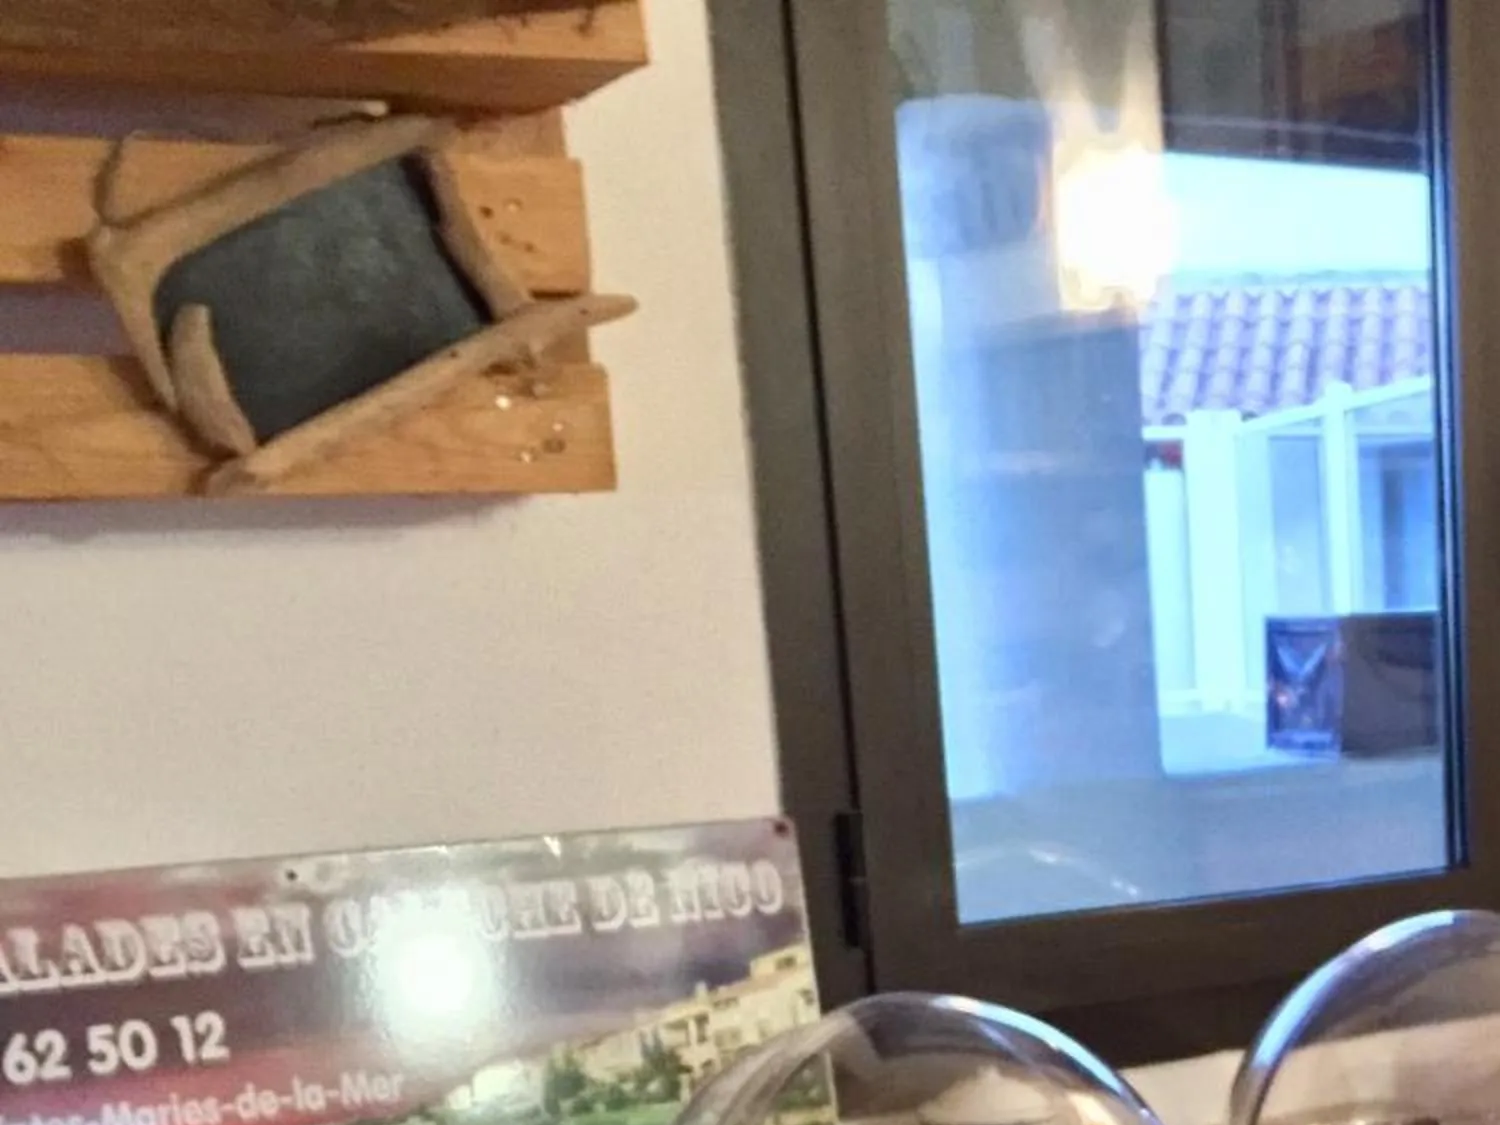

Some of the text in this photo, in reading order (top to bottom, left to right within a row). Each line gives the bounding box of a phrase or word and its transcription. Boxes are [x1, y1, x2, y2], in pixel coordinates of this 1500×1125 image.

[231, 902, 316, 969] EN
[323, 880, 582, 957] CCHE
[585, 867, 661, 931] DE
[667, 858, 783, 925] NICO
[3, 1010, 230, 1085] 62 50 12
